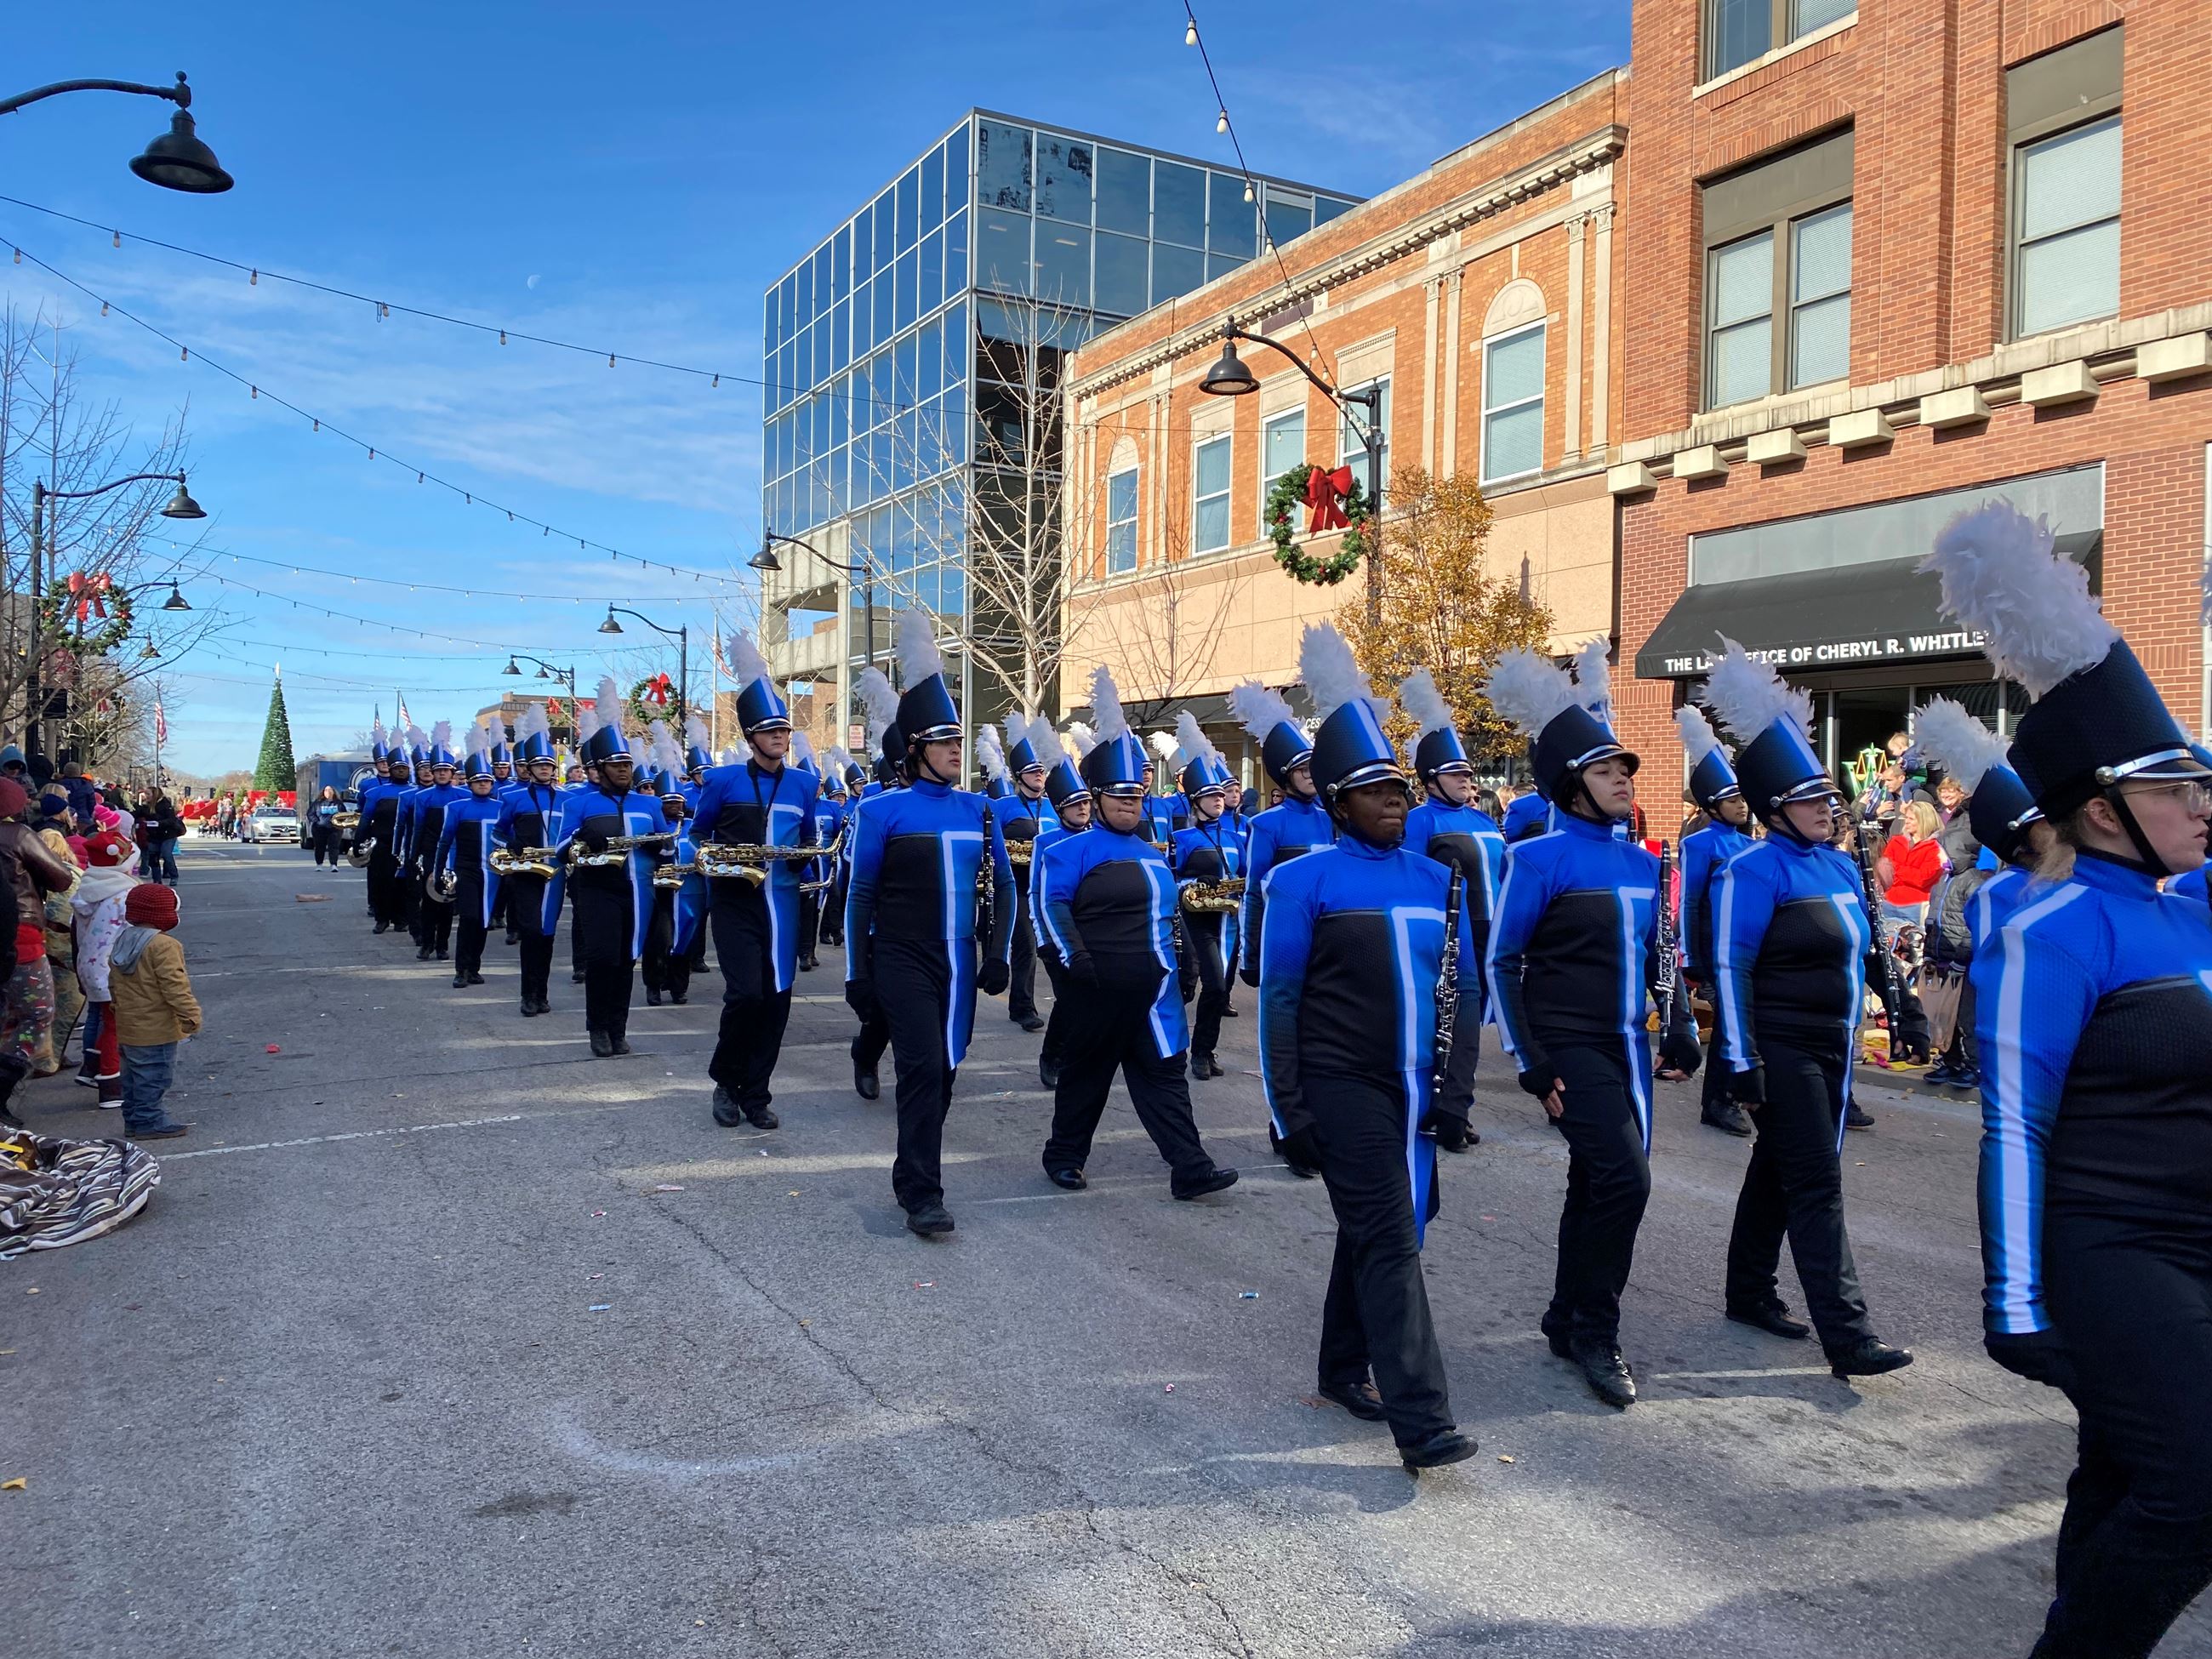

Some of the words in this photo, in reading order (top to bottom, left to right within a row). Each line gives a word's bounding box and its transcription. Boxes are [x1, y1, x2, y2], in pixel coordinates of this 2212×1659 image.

[1664, 657, 1693, 672] THE
[1744, 648, 1787, 664] FFICE
[1791, 647, 1813, 663] OF
[1816, 640, 1883, 660] CHERYL
[1886, 638, 1905, 654] R.
[1908, 630, 1989, 653] WHITLE
